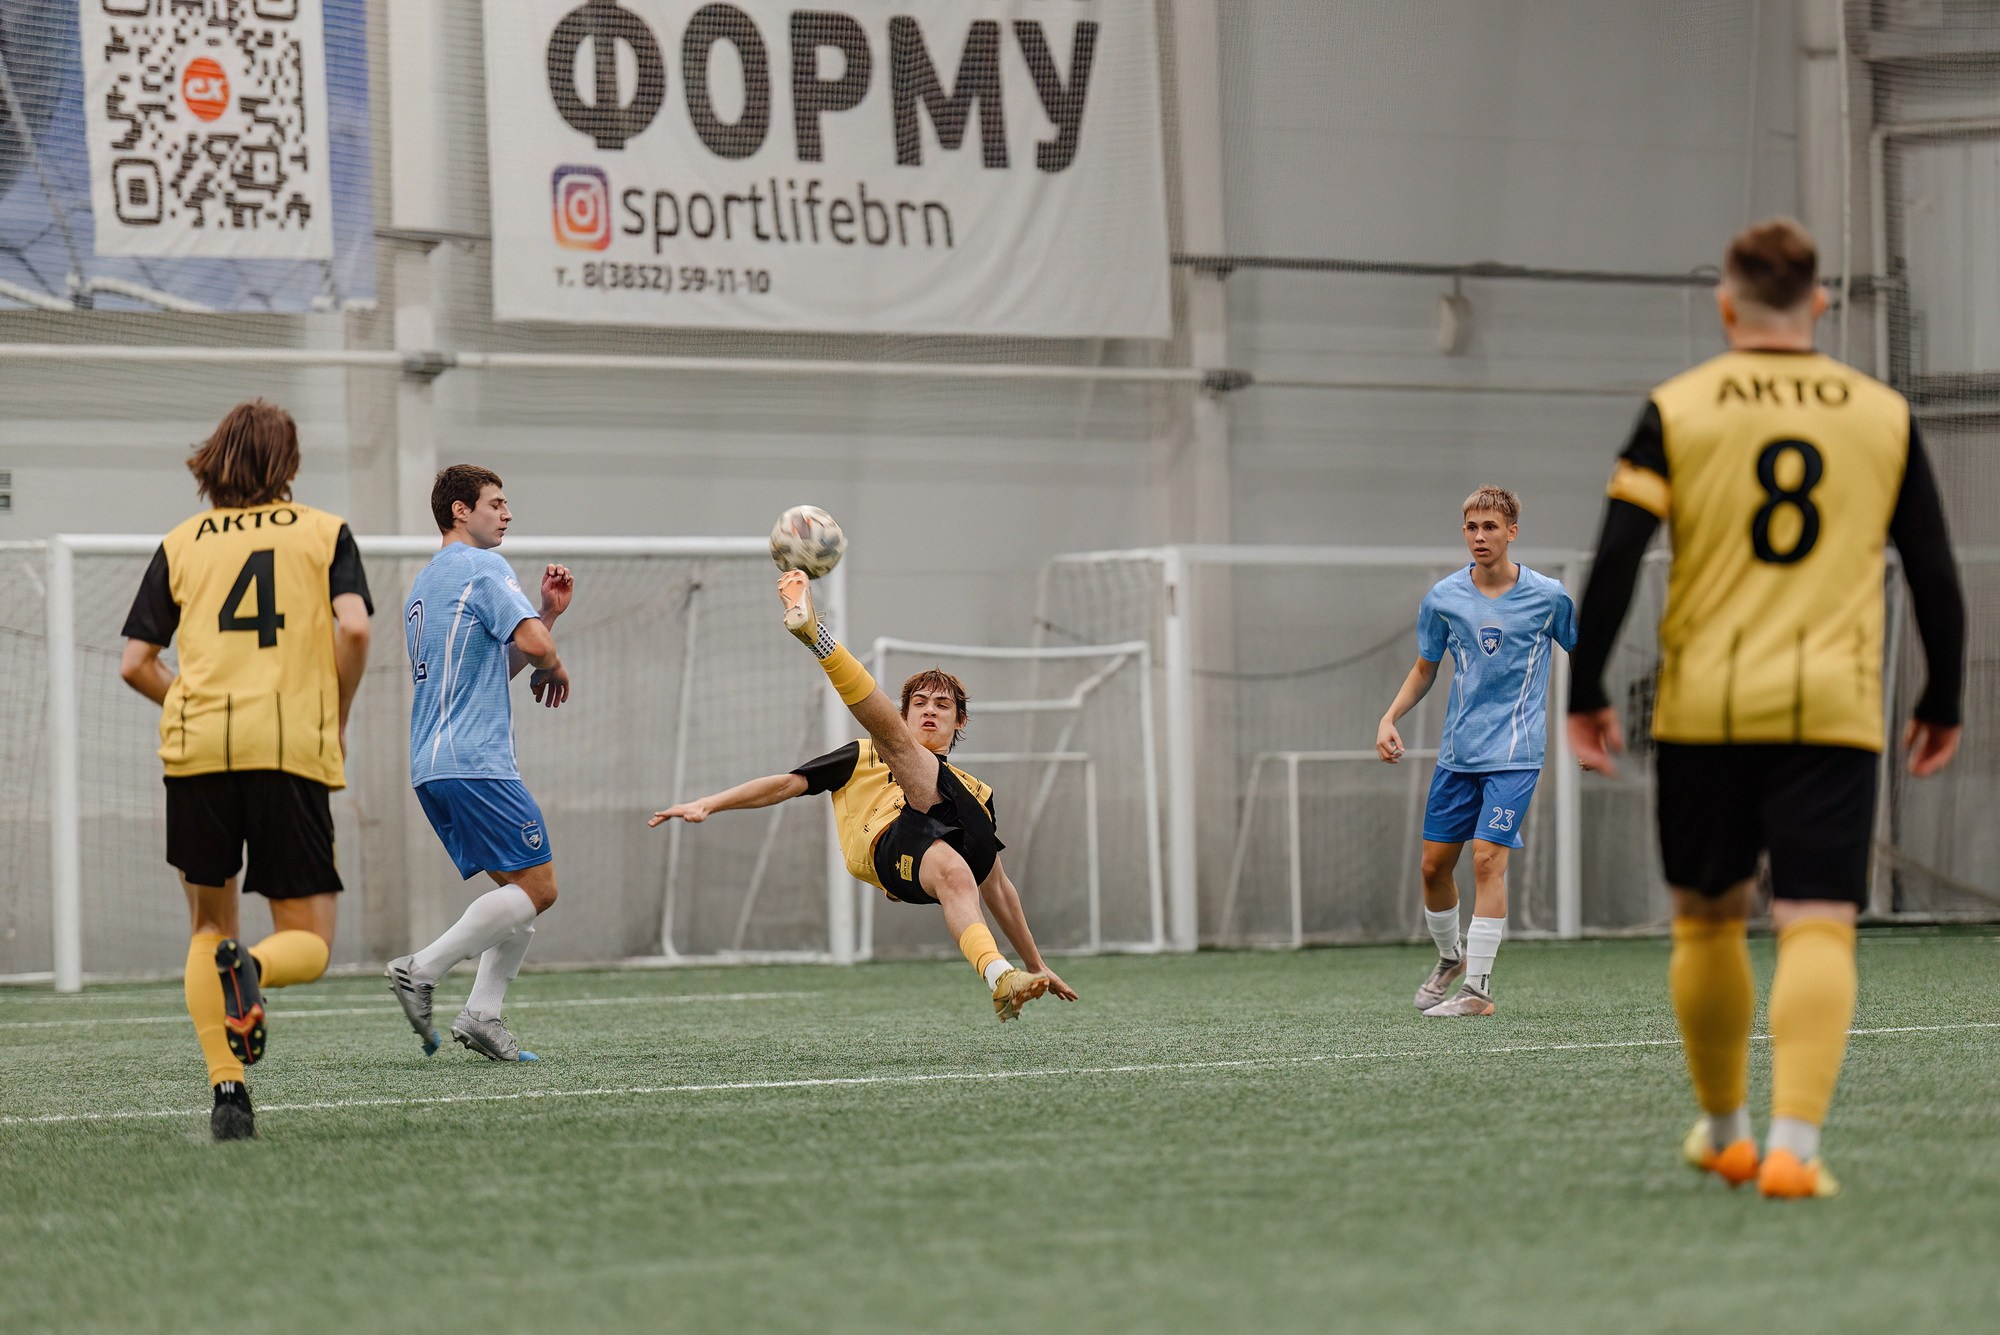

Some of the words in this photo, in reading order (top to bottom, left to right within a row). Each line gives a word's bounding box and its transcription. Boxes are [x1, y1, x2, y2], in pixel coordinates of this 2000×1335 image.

[546, 0, 1100, 172] ФОРМУ
[621, 177, 954, 253] sportlifebrn
[582, 262, 672, 293] 8(3852)
[195, 508, 298, 541] AKTO
[1752, 438, 1824, 566] 8
[218, 548, 285, 649] 4
[1488, 806, 1516, 832] 23
